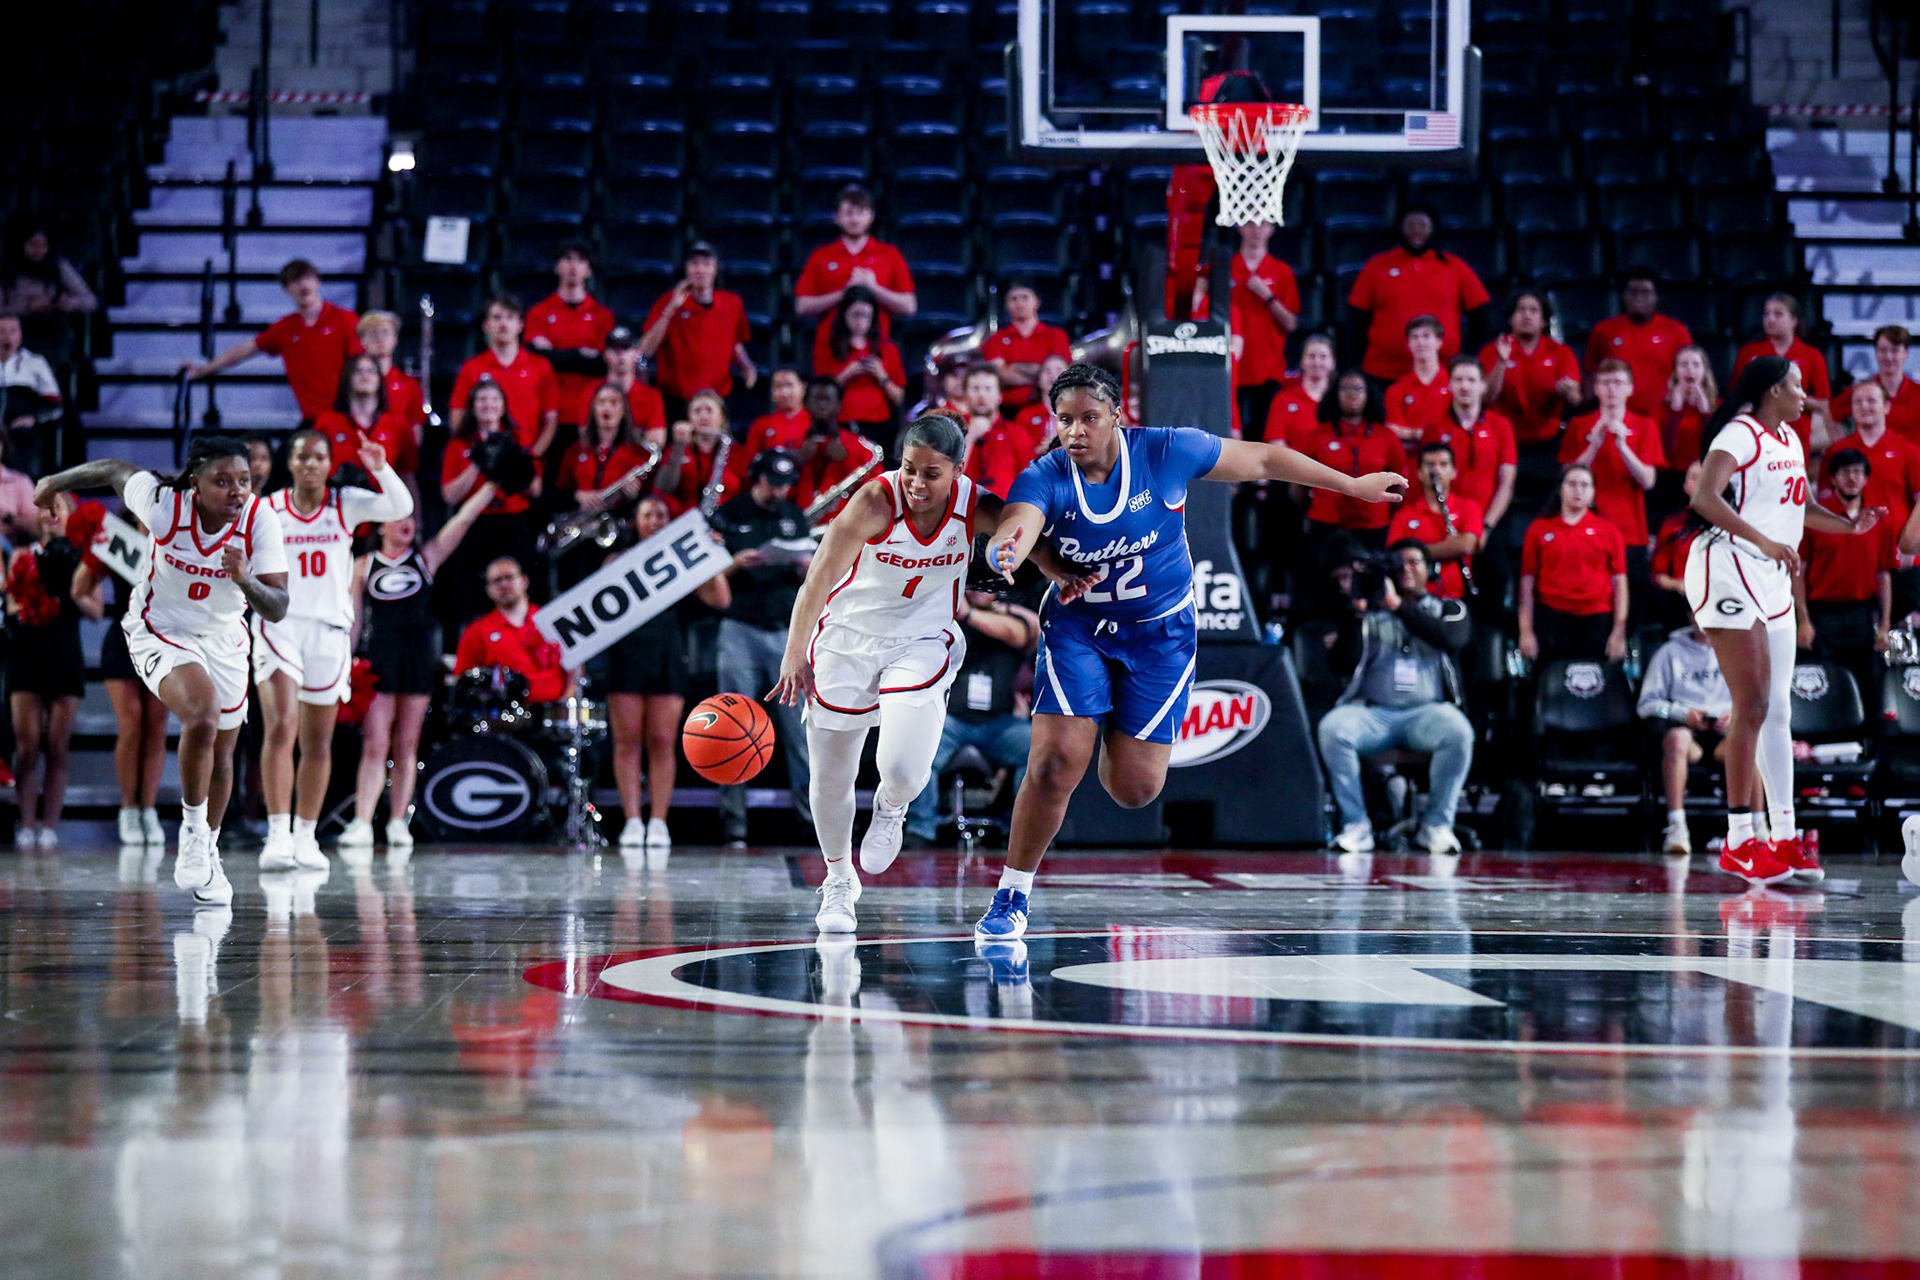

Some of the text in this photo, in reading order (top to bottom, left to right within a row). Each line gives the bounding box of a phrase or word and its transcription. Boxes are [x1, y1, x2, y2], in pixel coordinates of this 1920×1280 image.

[1146, 335, 1228, 355] SPALDING
[1767, 460, 1804, 471] GEOR
[1127, 489, 1152, 513] SBC
[1780, 476, 1806, 506] 30
[283, 534, 340, 545] EORGIA
[1059, 530, 1159, 563] Panthers
[164, 553, 234, 579] GEORG
[298, 551, 326, 577] 10
[875, 552, 964, 569] GEORGIA
[188, 582, 211, 600] 0
[553, 530, 709, 648] NOISE
[901, 575, 924, 599] 1
[1082, 555, 1148, 603] 22
